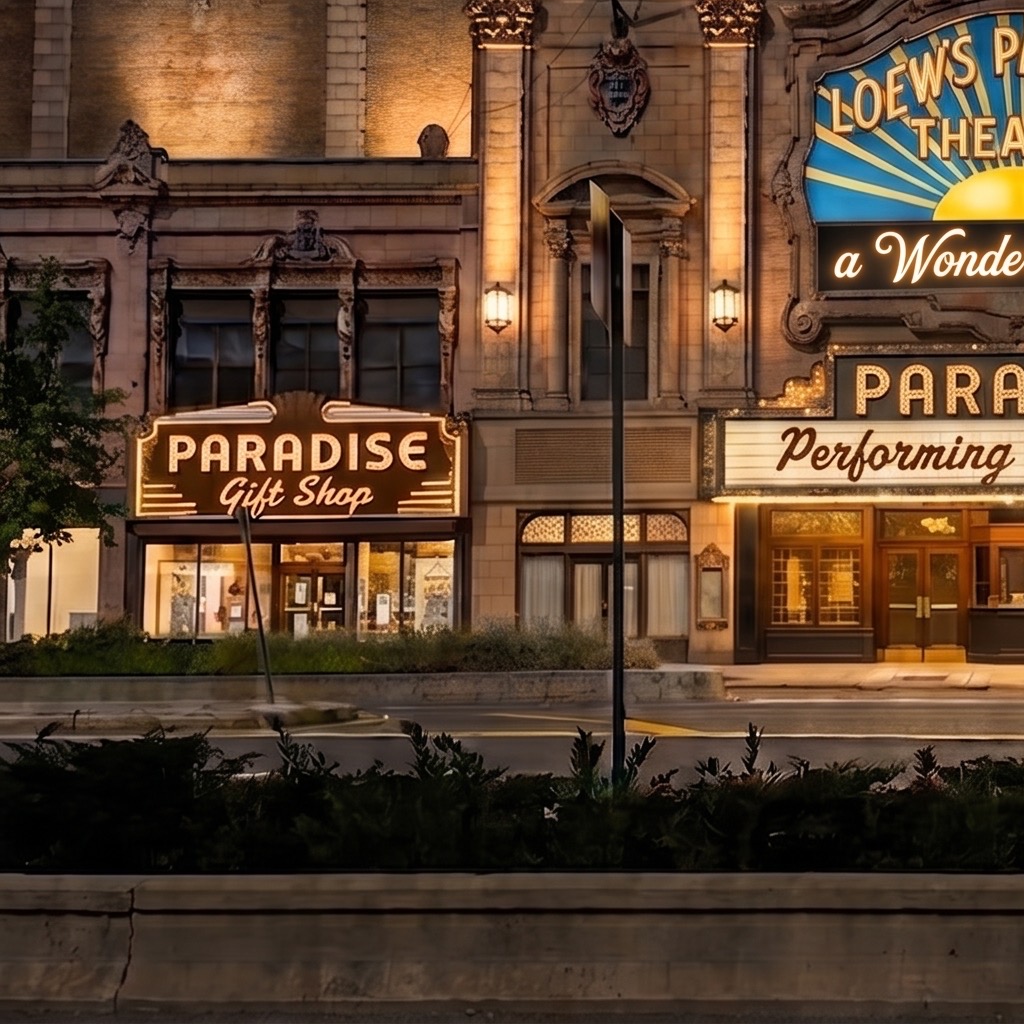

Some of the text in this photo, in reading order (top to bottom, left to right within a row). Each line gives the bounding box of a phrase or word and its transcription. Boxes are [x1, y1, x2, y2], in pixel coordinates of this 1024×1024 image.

[831, 34, 978, 134] LOEW'S
[833, 250, 863, 279] a
[168, 431, 428, 473] PARADISE
[775, 426, 1015, 486] Performing
[219, 474, 374, 519] Gift Shop
